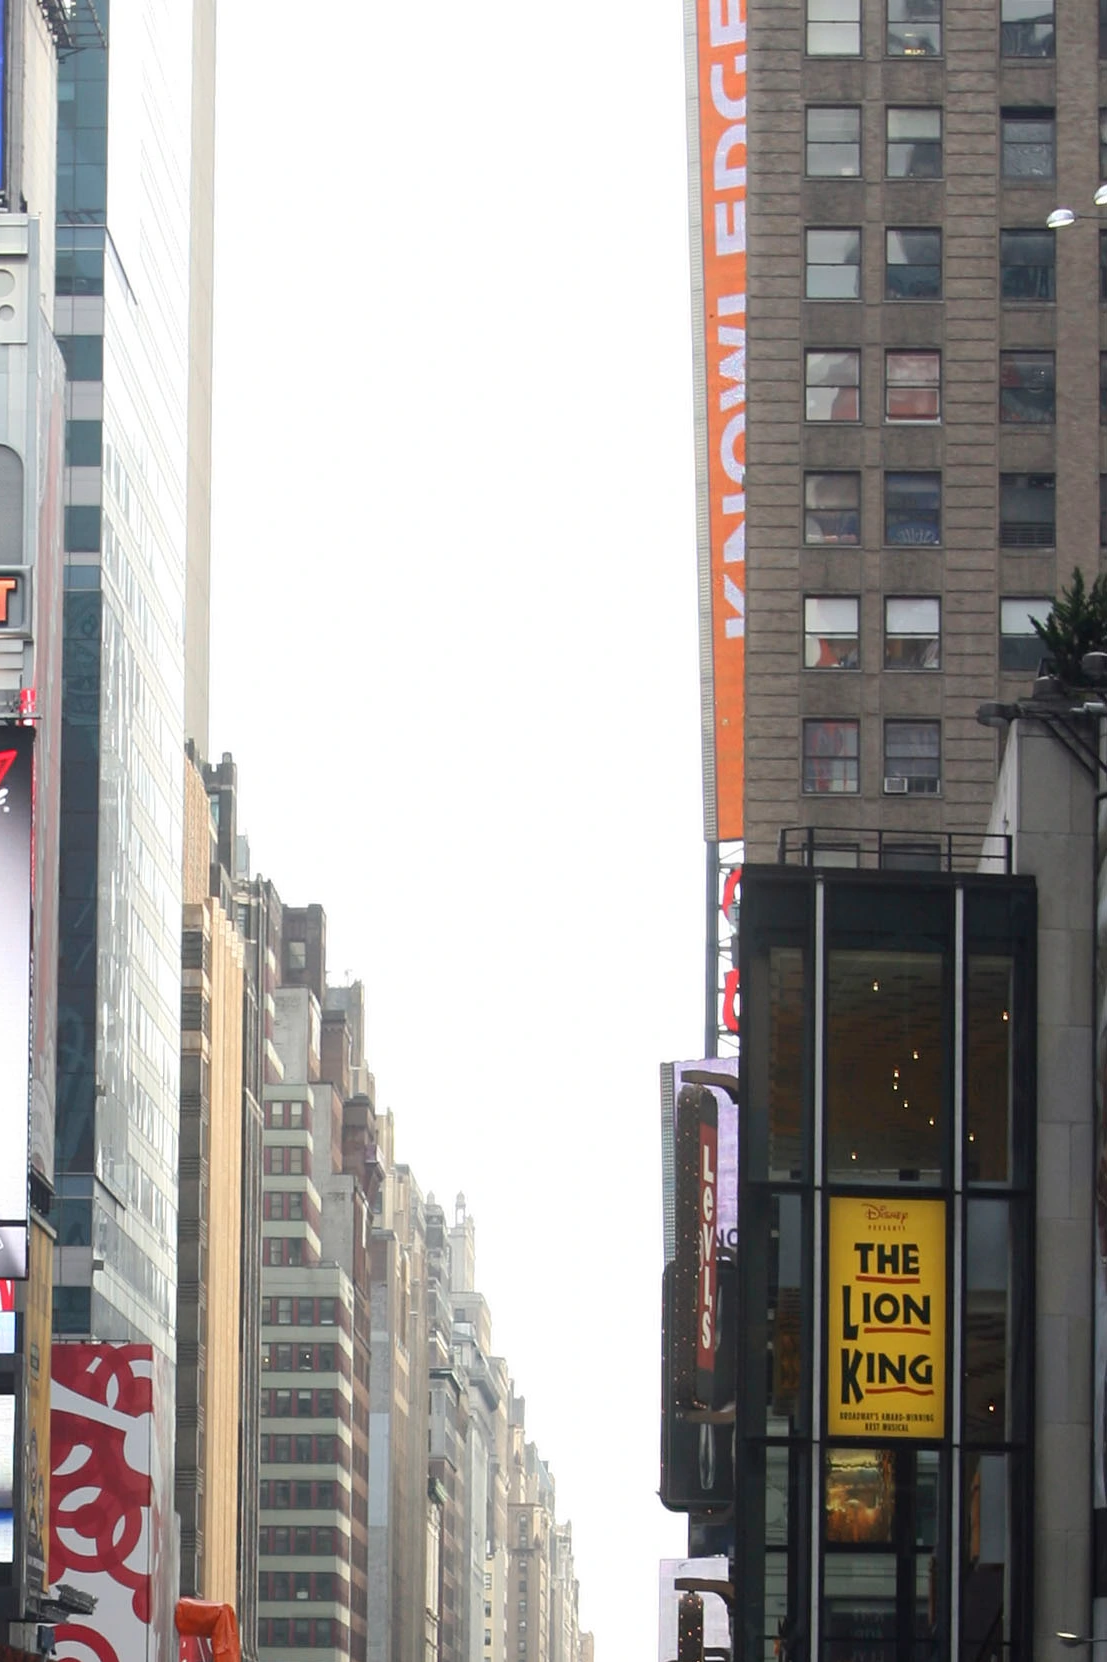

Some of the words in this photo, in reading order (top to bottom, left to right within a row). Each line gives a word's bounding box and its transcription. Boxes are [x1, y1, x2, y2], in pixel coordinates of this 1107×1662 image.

[854, 1243, 920, 1275] THE
[842, 1285, 931, 1341] LION
[841, 1348, 933, 1404] KING
